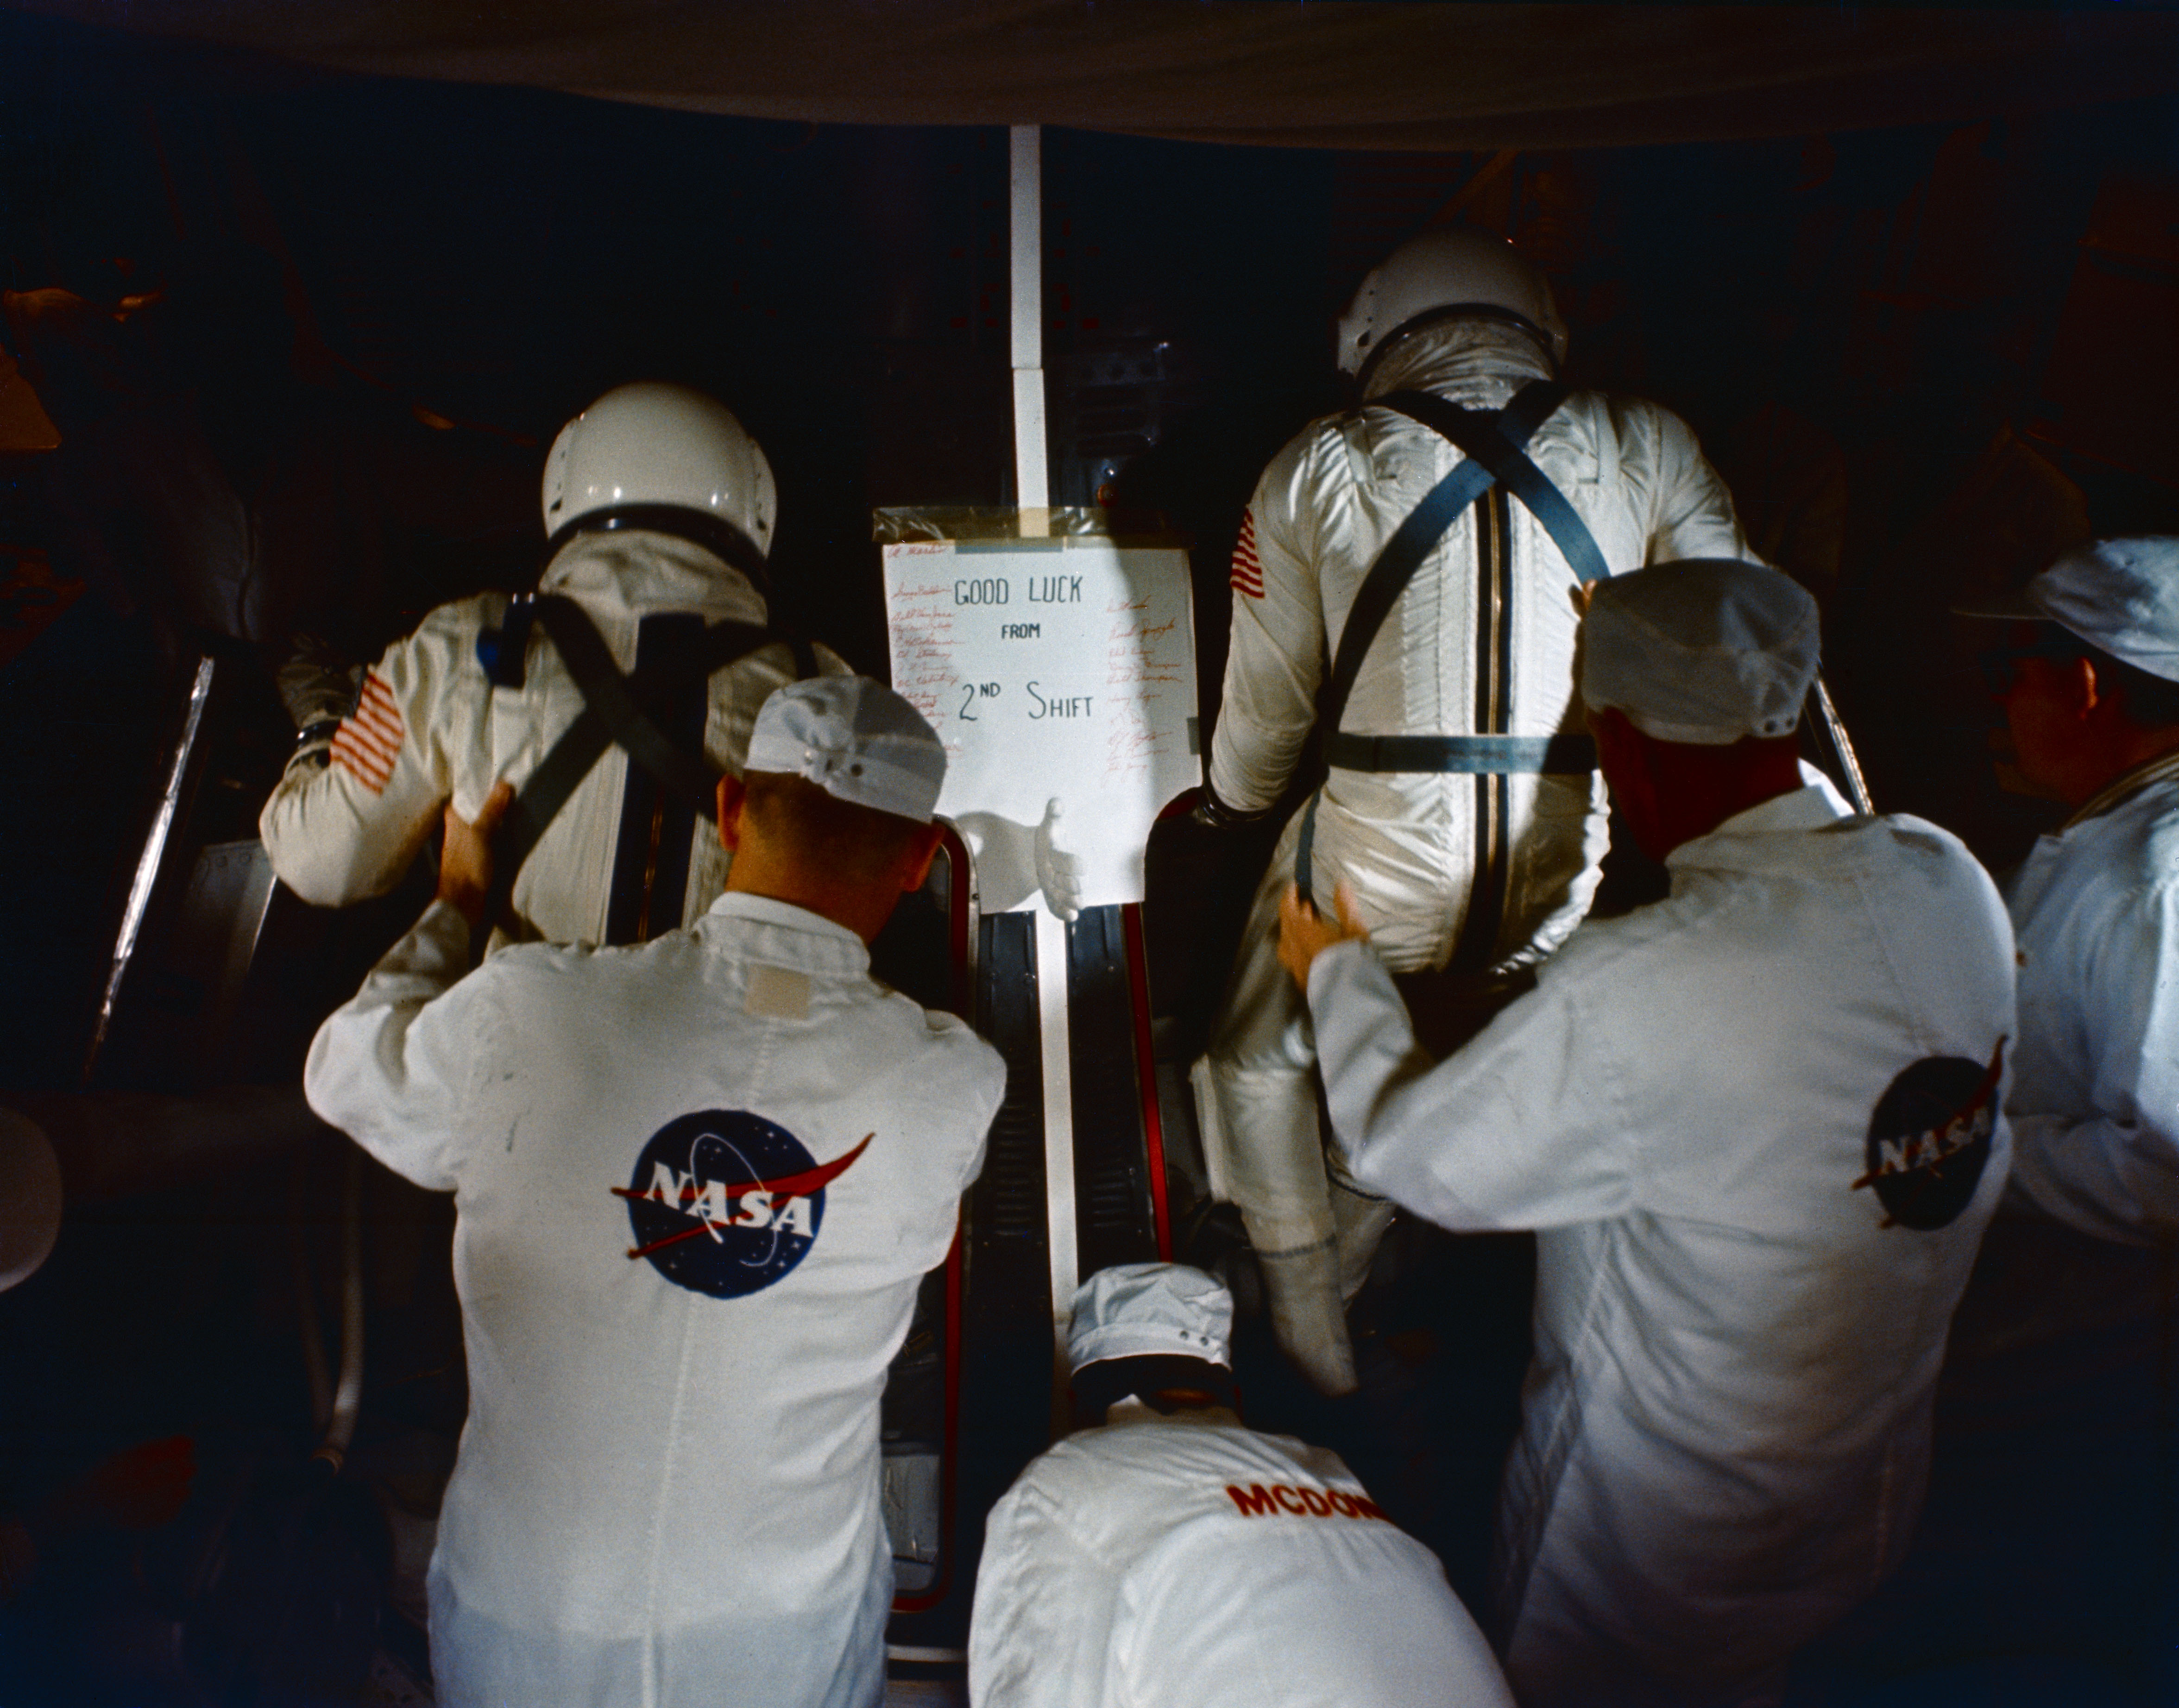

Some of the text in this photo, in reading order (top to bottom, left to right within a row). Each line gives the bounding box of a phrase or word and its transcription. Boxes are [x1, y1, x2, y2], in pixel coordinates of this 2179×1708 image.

[954, 578, 1009, 605] GOOD
[1029, 576, 1082, 603] LUCK
[1001, 623, 1040, 639] FROM
[1877, 1105, 1989, 1176] NASA
[642, 1161, 813, 1237] NASA
